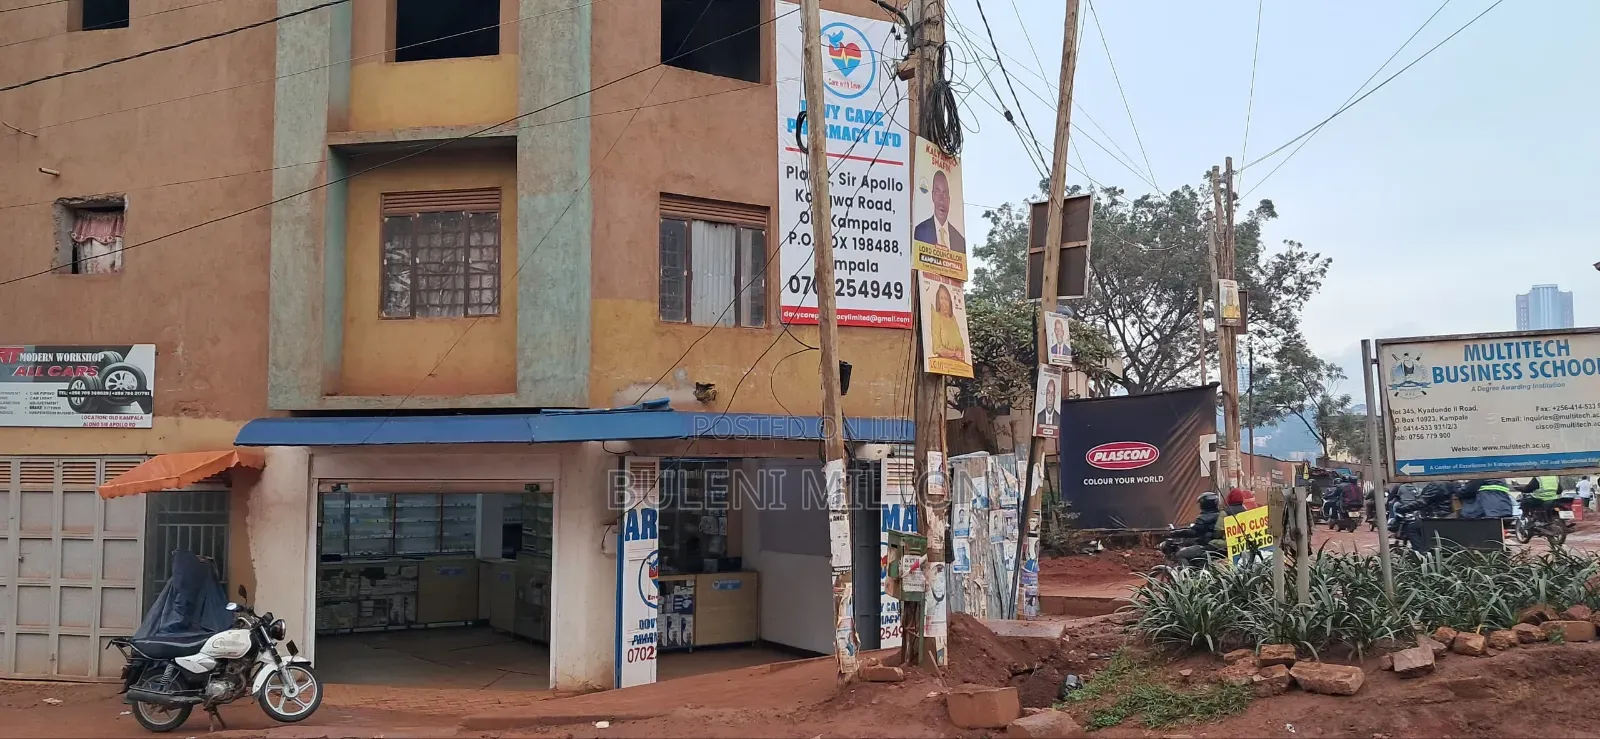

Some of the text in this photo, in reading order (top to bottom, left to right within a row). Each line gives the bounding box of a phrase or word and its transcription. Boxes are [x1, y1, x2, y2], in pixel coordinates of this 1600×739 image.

[845, 106, 884, 127] CARE
[874, 130, 902, 148] LTD
[786, 165, 809, 182] Plo
[838, 172, 857, 187] Sir
[860, 175, 904, 194] Apollo
[858, 195, 896, 215] Road,
[799, 211, 892, 235] Ol Kampala
[788, 231, 903, 257] P.O. OX 198488,
[918, 244, 933, 255] LORD
[834, 258, 880, 276] mpala
[788, 275, 904, 300] 07254949
[19, 352, 54, 363] MODERN
[56, 352, 105, 363] WORKSHOP
[1463, 339, 1571, 362] MULTITECH
[12, 365, 100, 377] ALL CARS
[1431, 362, 1524, 384] BUSINESS
[1477, 385, 1500, 394] Degree
[1500, 383, 1531, 392] Awarding
[1532, 381, 1566, 390] Institution
[1417, 406, 1452, 416] Kyadondo
[1439, 413, 1469, 422] Kampala
[1535, 405, 1551, 413] Fax:
[1501, 415, 1522, 423] Email:
[1093, 449, 1151, 462] PLASCON
[1450, 442, 1551, 453] Website: www.multitech.ac.ug
[1083, 475, 1164, 486] COLOUR YOUR WORLD
[624, 507, 658, 541] AR
[881, 503, 918, 532] MA
[1226, 522, 1247, 538] ROAD
[638, 618, 657, 630] DOV
[627, 645, 657, 664] 0702
